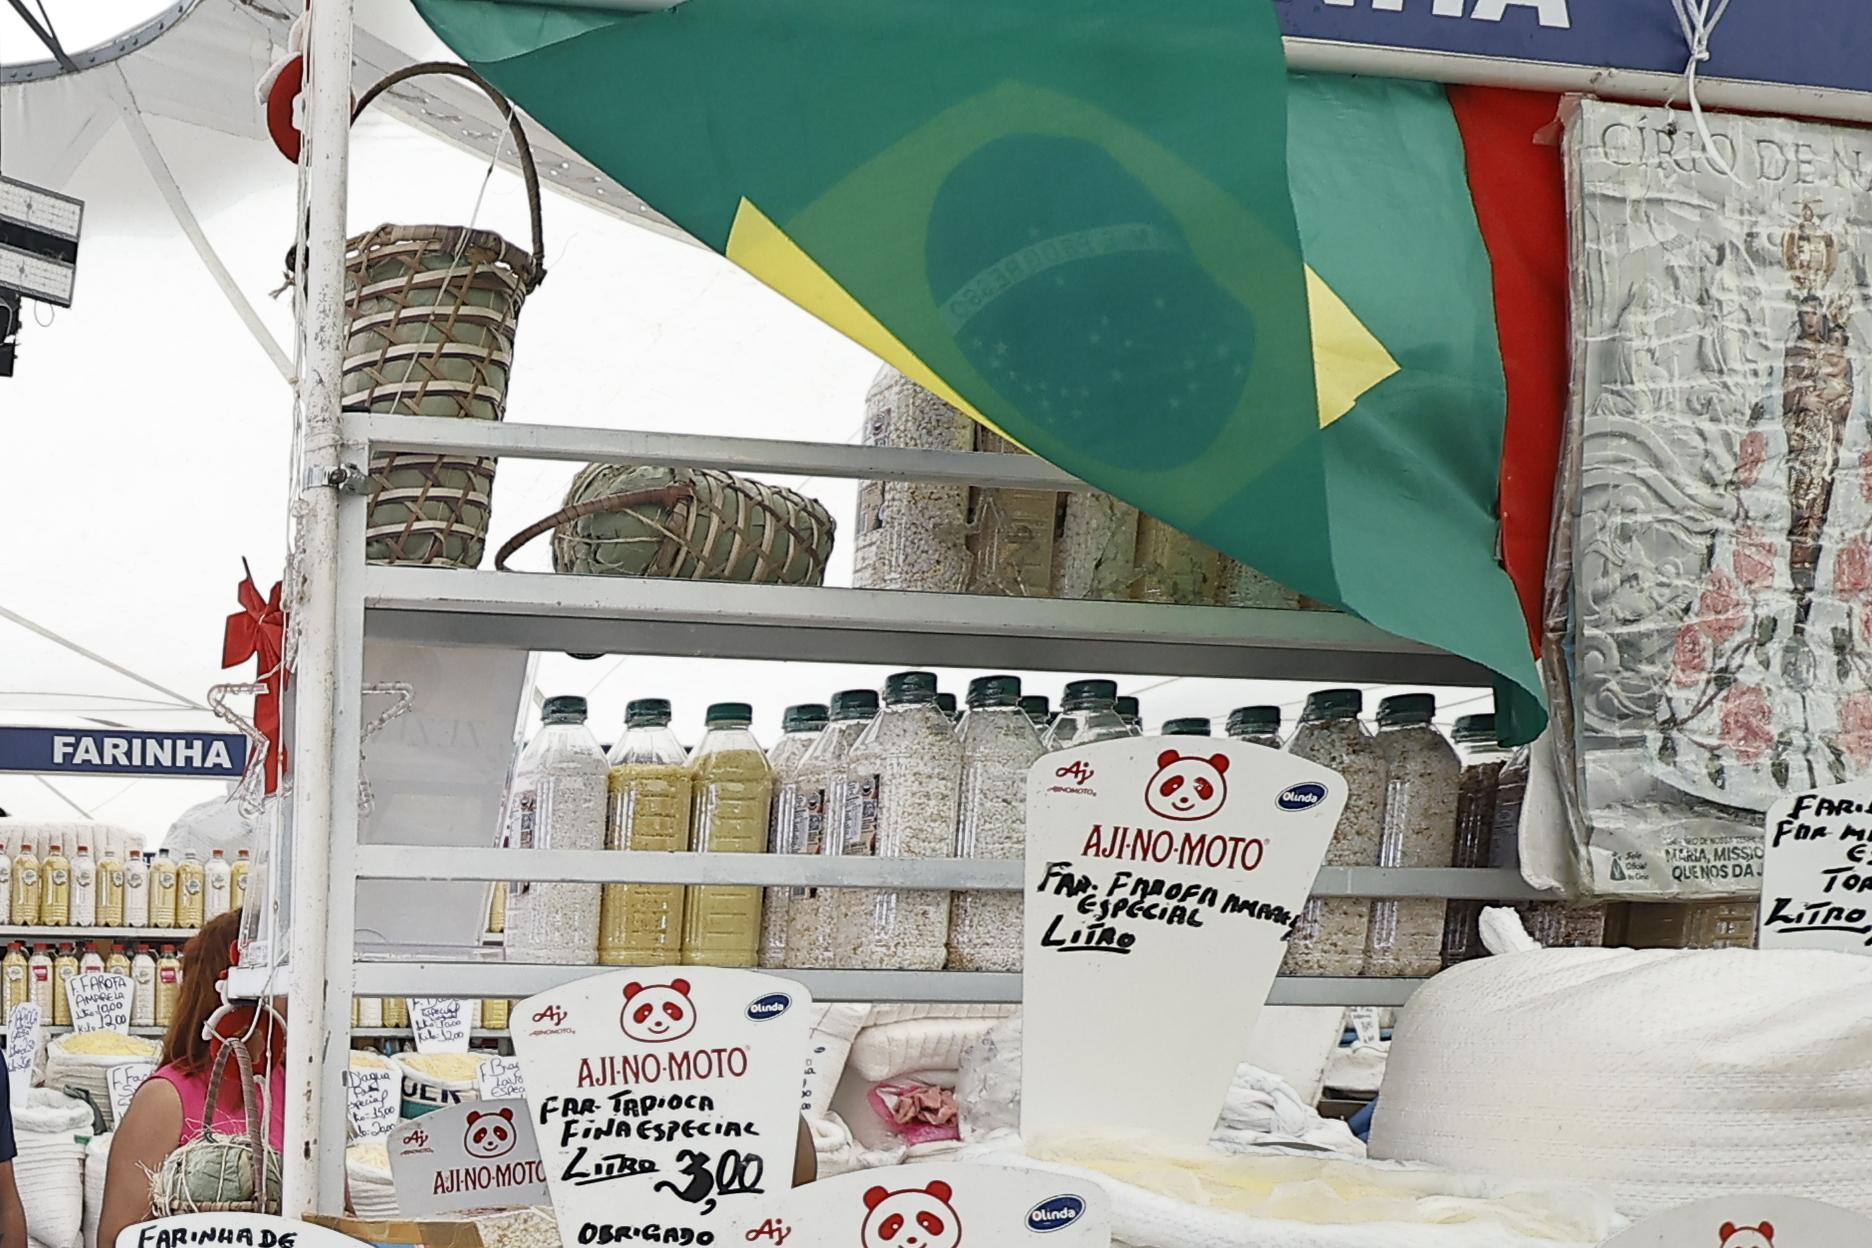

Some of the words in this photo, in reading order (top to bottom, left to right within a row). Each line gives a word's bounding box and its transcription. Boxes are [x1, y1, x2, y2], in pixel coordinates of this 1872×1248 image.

[52, 734, 233, 769] FARINHA
[1282, 790, 1319, 804] Olinda
[1714, 846, 1764, 861] MISSIO
[1078, 893, 1204, 928] ESPECIAL
[1764, 897, 1866, 930] LITRO
[1040, 914, 1136, 950] LITRO
[750, 1002, 785, 1014] Olinda
[607, 1090, 715, 1118] TAPIOCA
[561, 1118, 631, 1148] FINA
[636, 1119, 760, 1142] ESPECIAL
[561, 1147, 660, 1182] LITRO
[1031, 1205, 1078, 1222] Olinda
[577, 1222, 715, 1247] OBRIGADO
